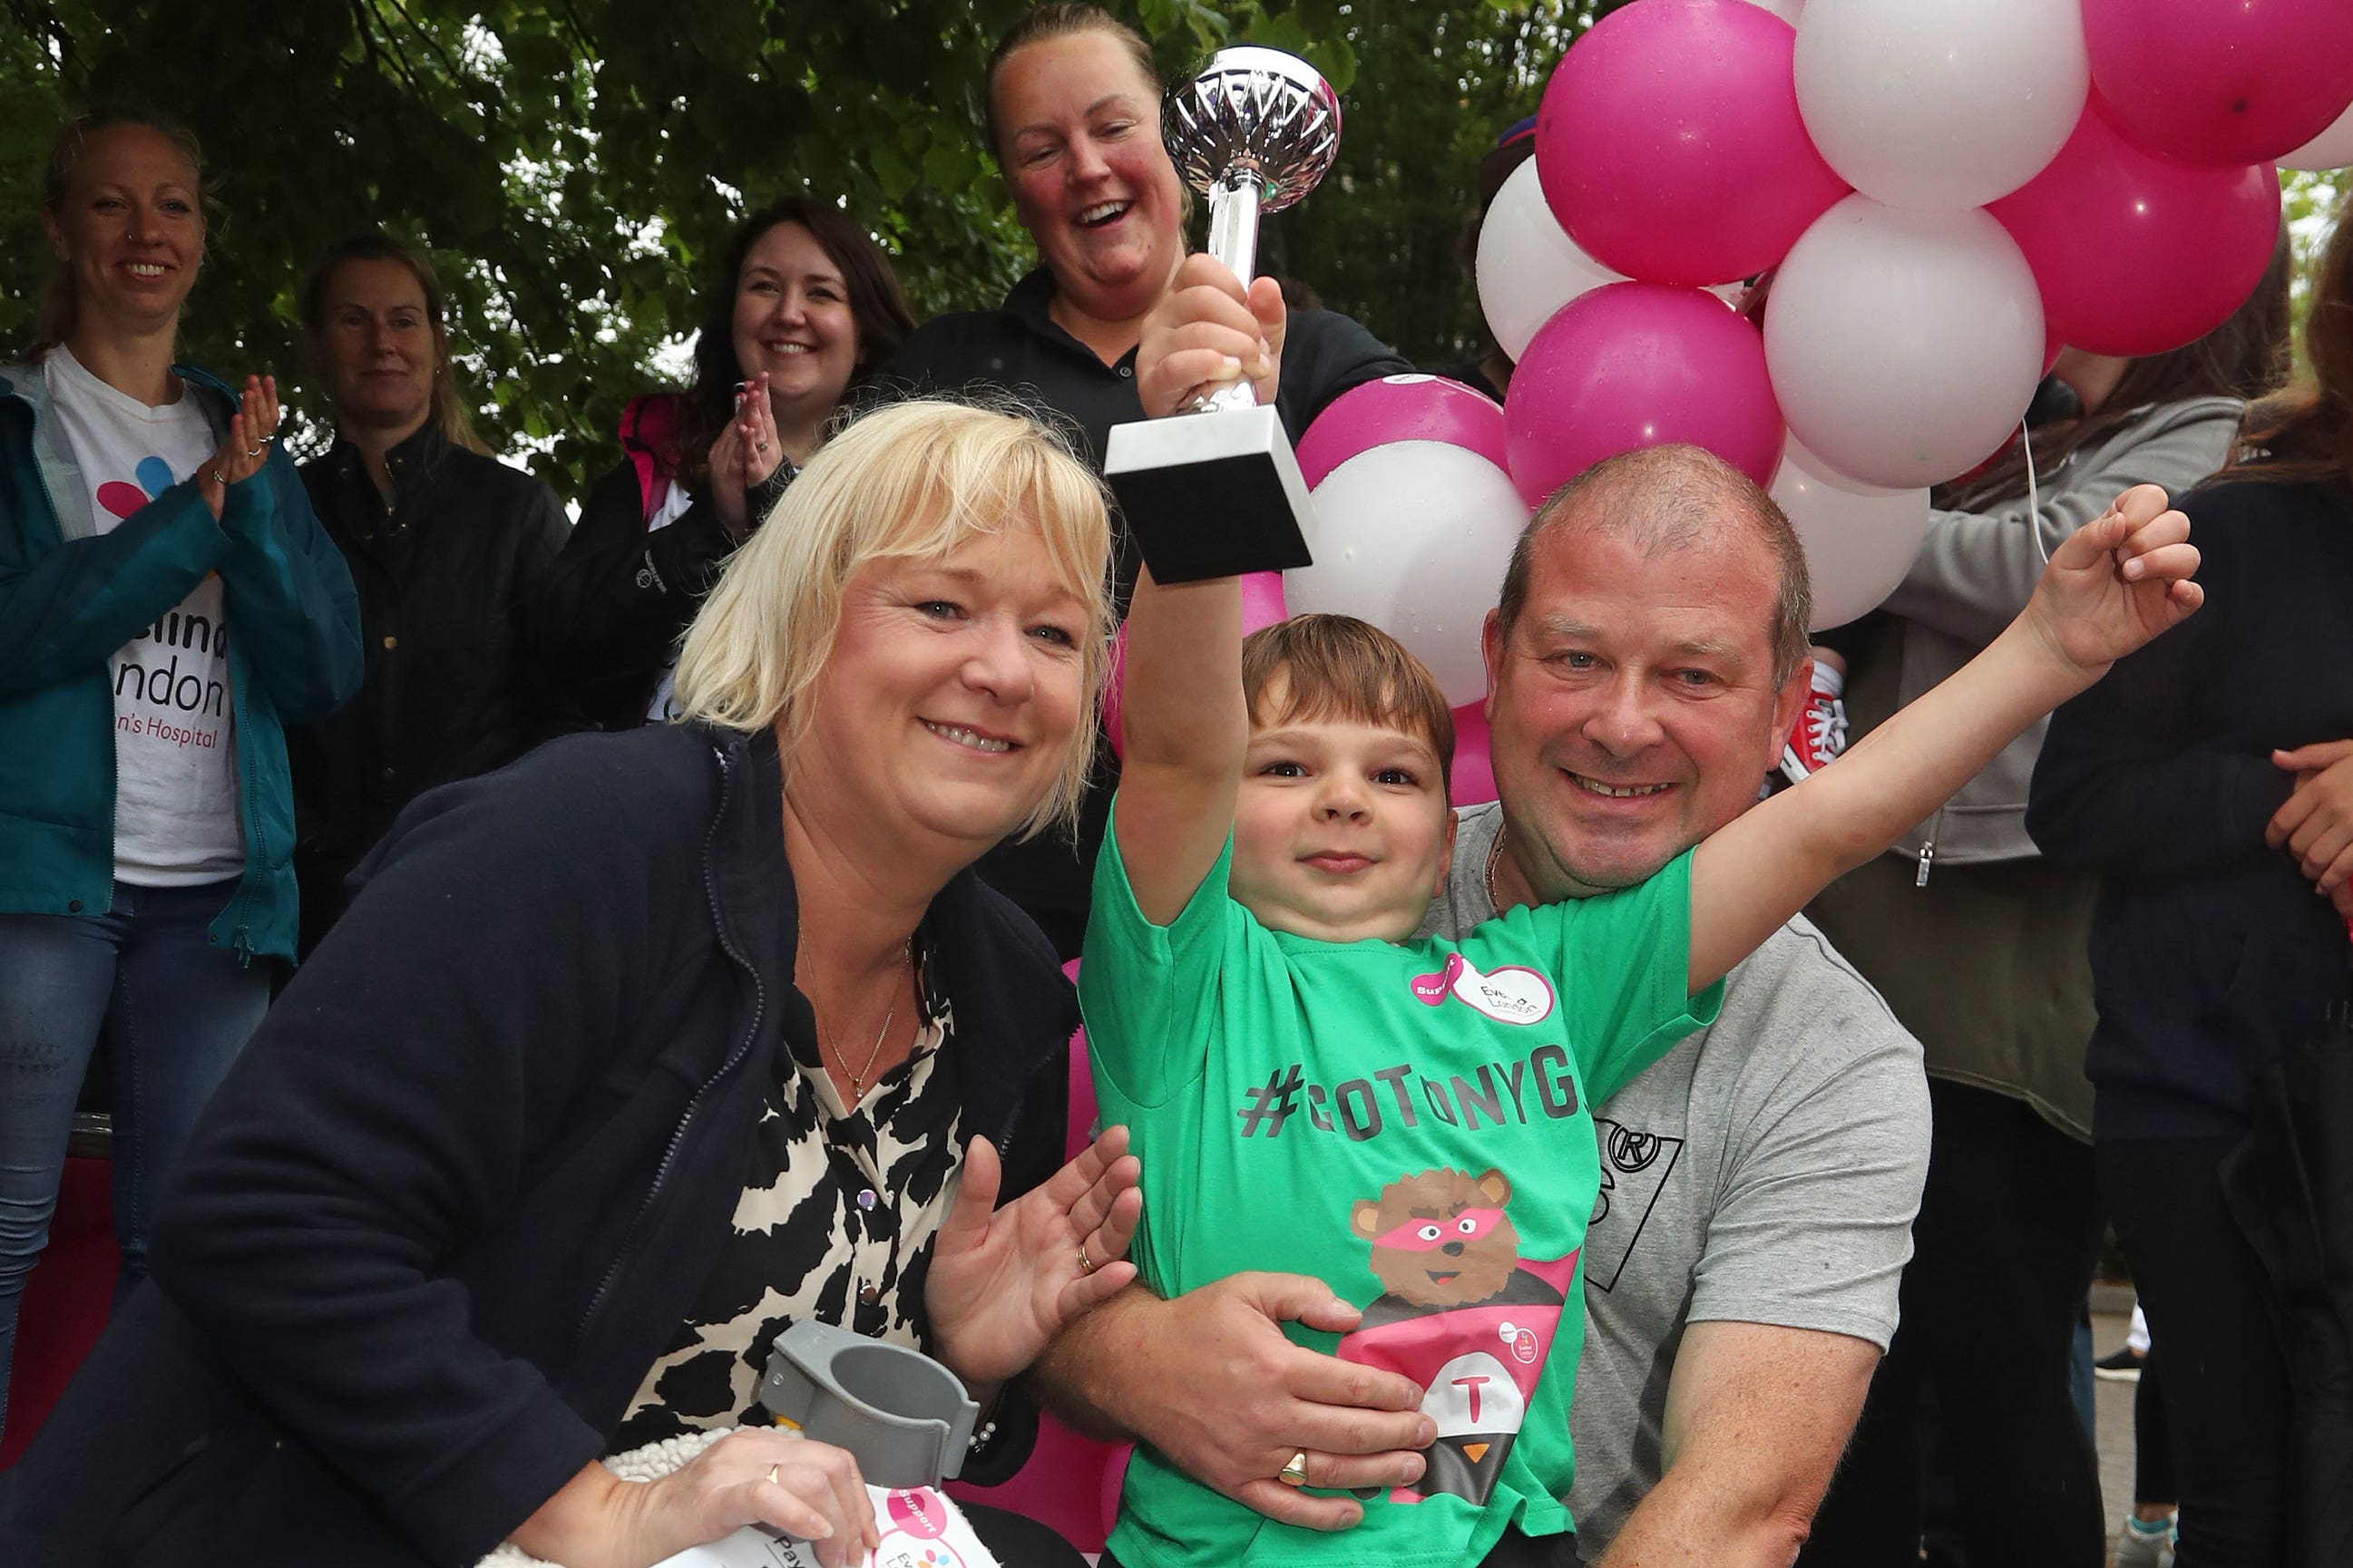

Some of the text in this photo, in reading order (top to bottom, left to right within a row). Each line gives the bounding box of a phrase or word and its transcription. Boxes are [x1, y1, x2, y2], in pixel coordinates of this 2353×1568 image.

[115, 655, 223, 716] ndon
[146, 716, 218, 748] Hospital
[1237, 1044, 1589, 1143] #GOTONYG
[1451, 1376, 1490, 1424] T
[898, 1488, 936, 1533] Support
